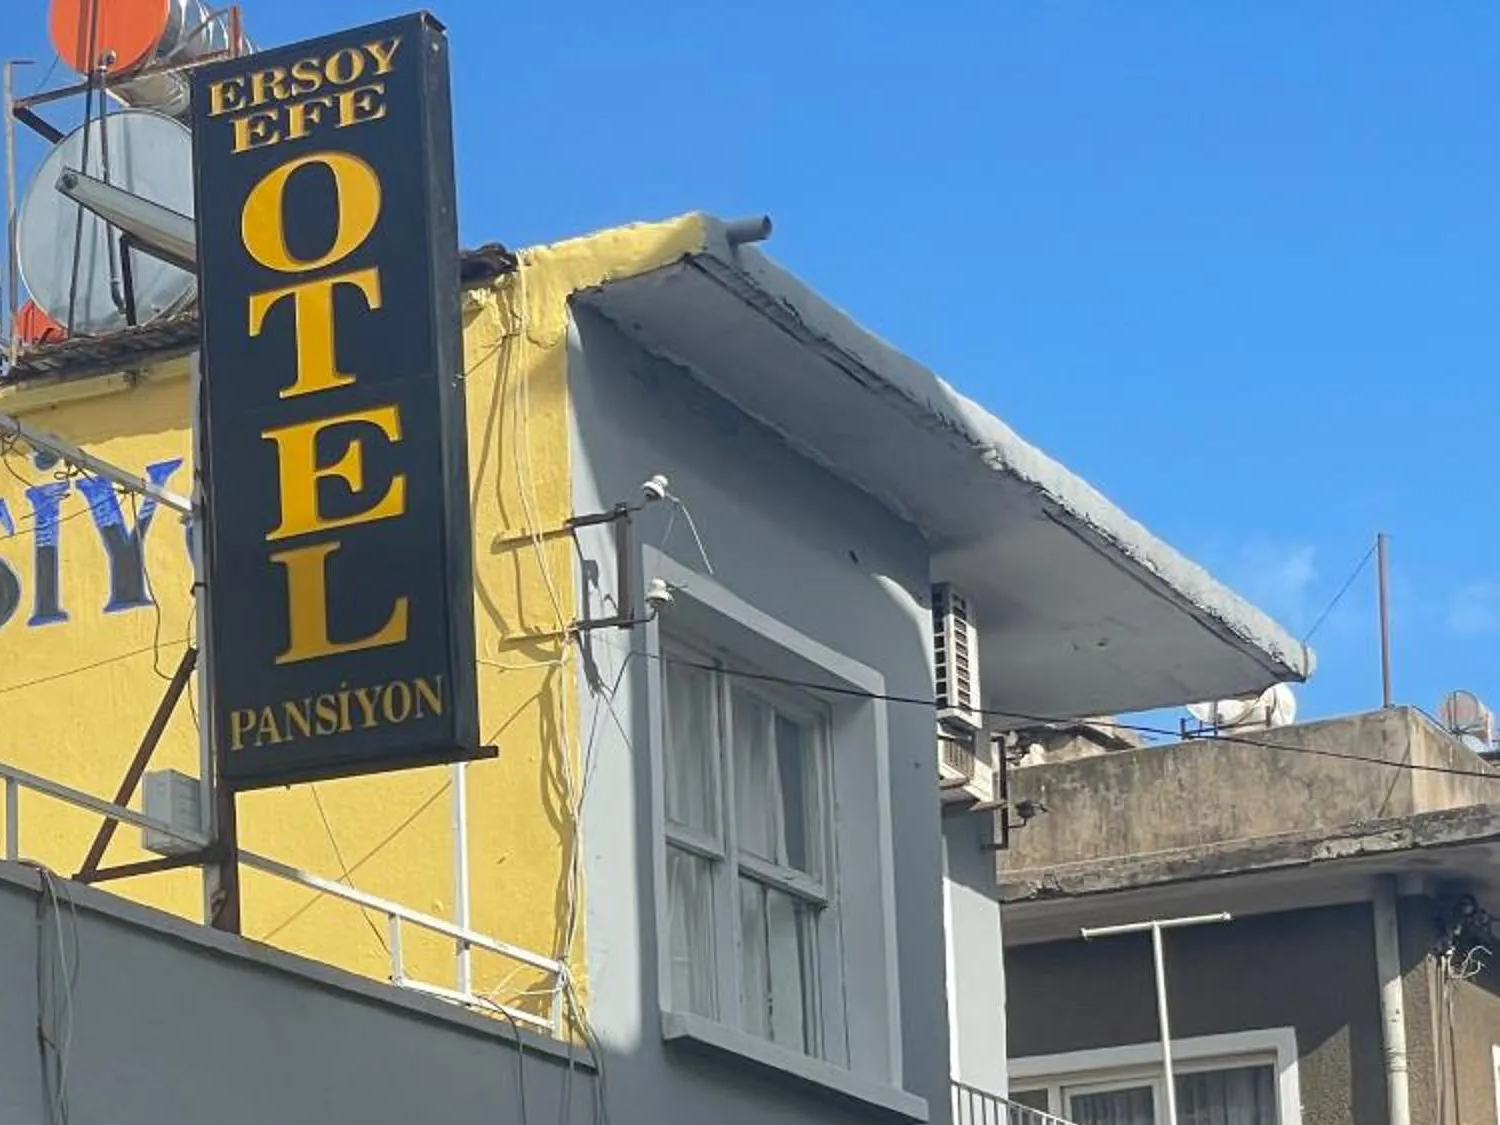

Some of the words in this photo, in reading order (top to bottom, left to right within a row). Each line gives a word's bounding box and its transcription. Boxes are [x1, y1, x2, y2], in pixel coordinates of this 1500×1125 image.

[208, 37, 402, 117] ERSOY
[230, 84, 388, 154] EFE
[241, 151, 409, 666] OTEL
[230, 674, 444, 751] PANSİYON
